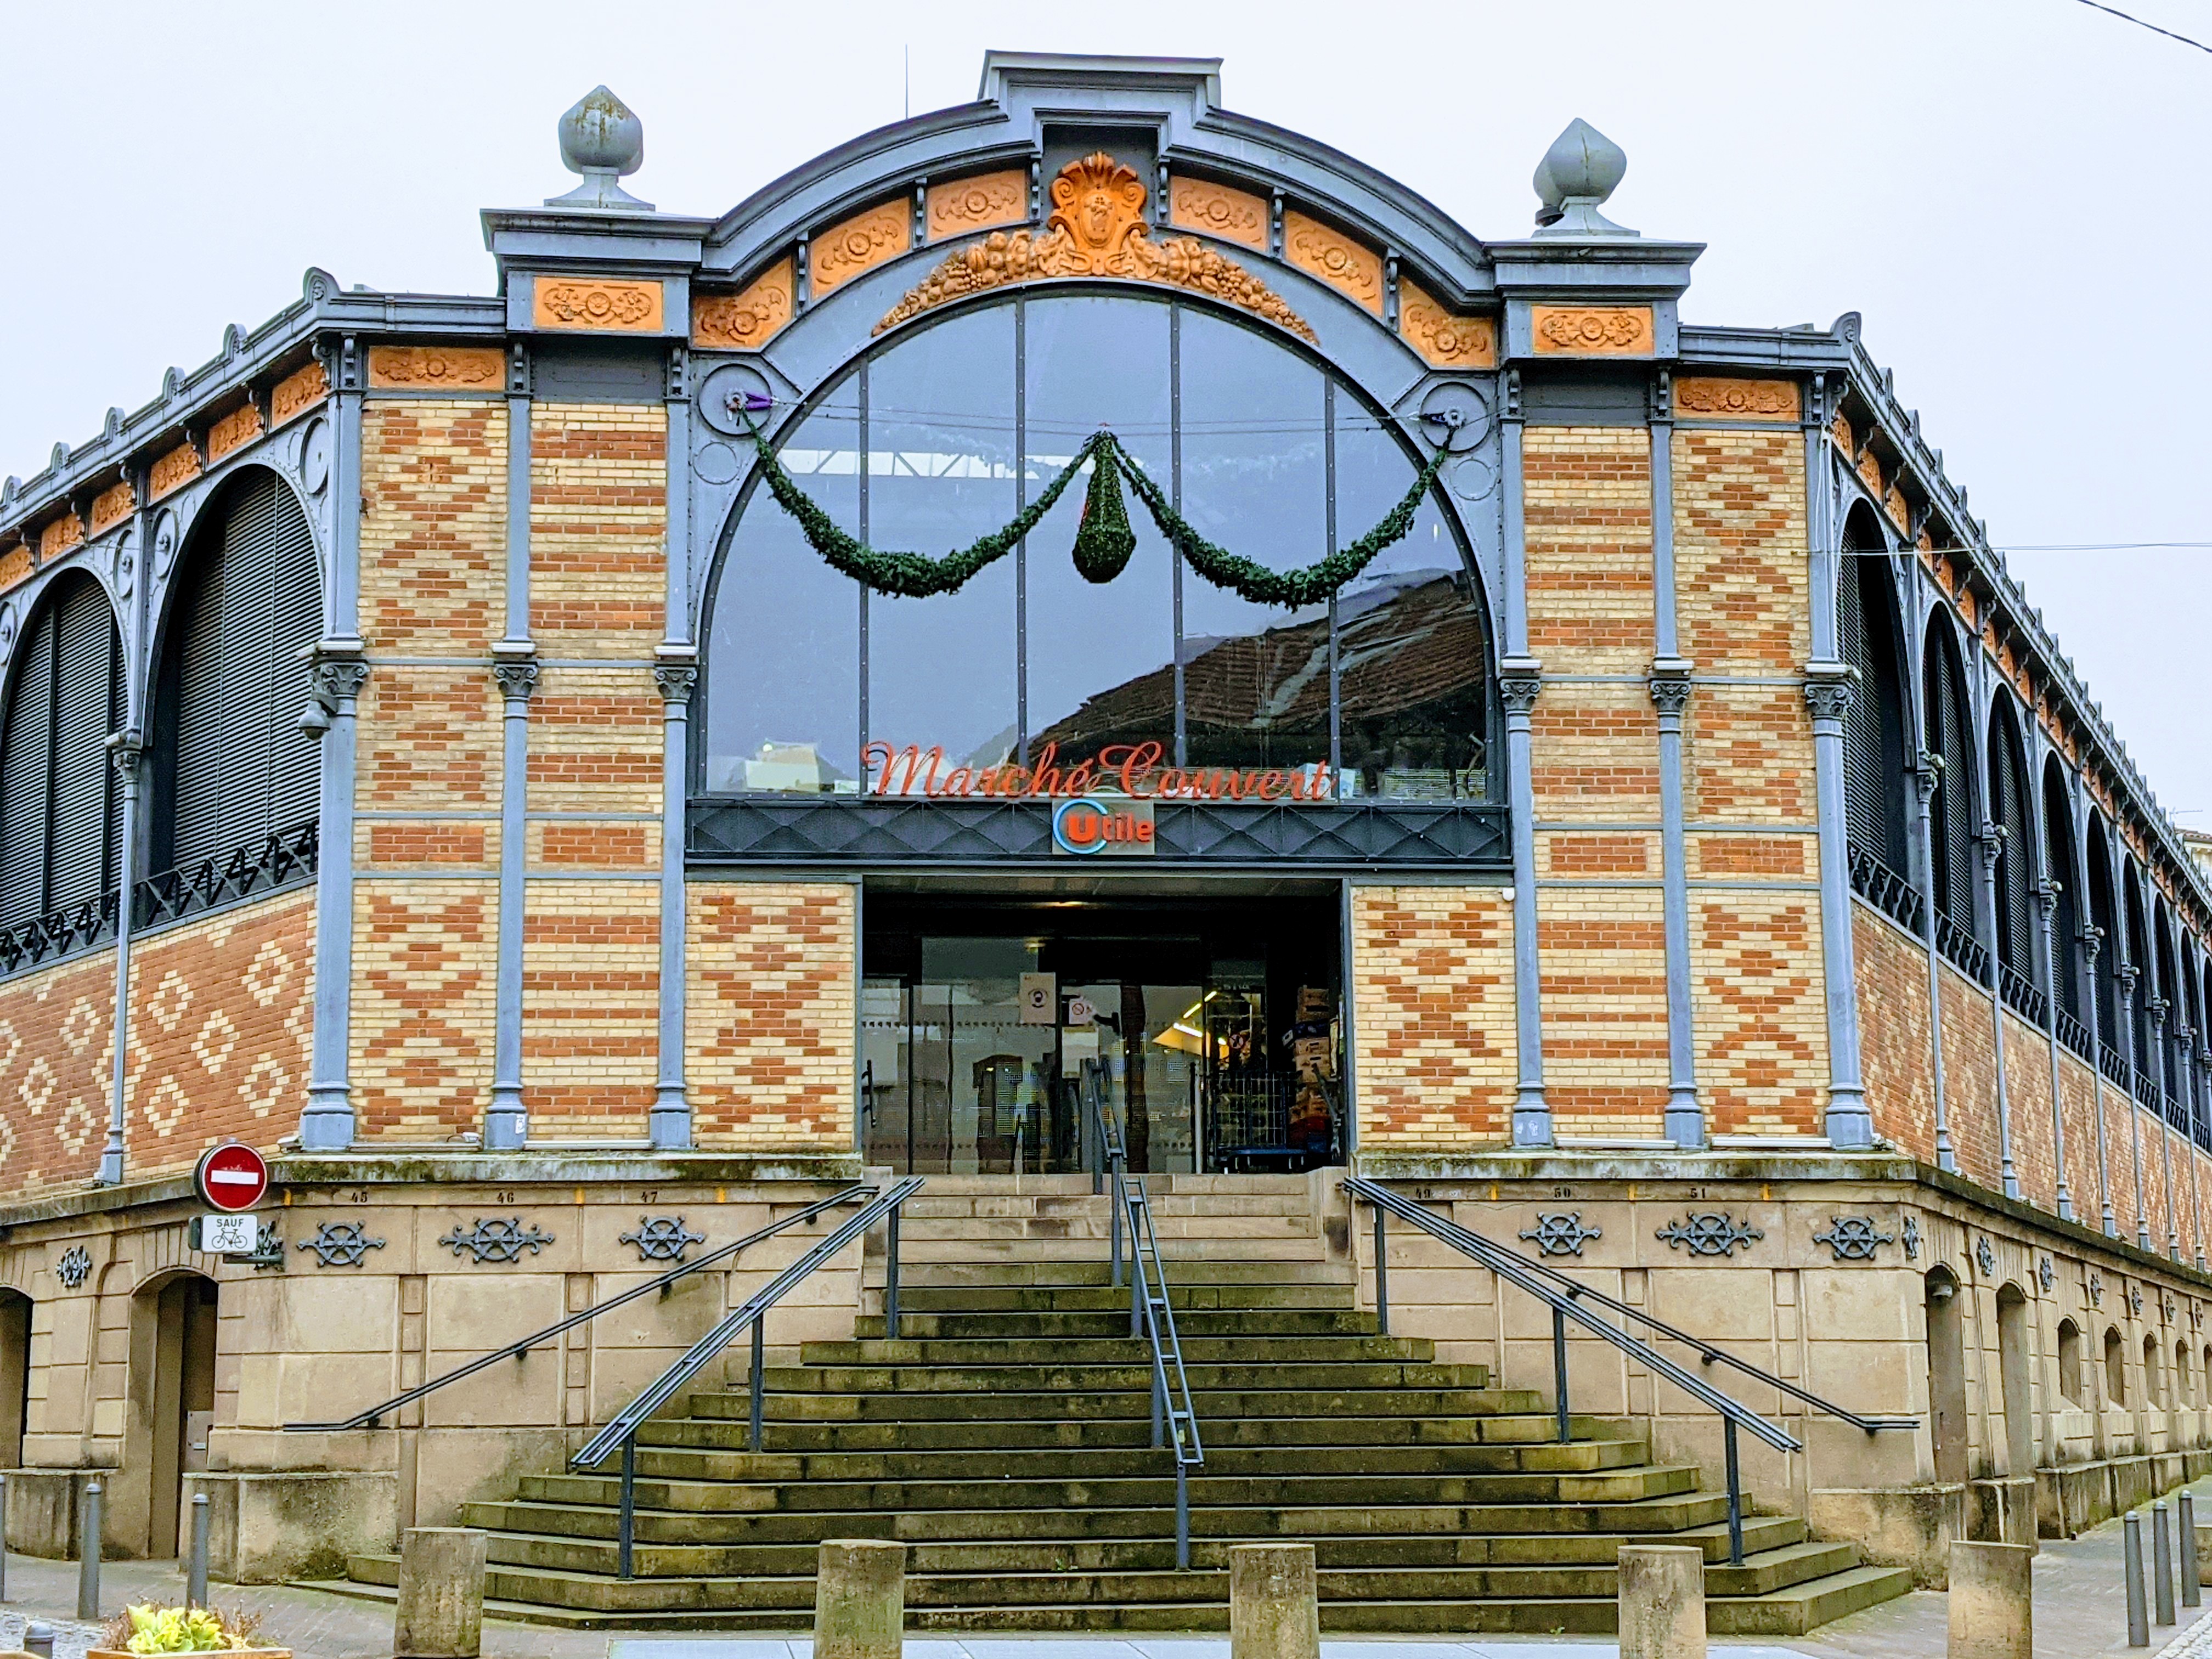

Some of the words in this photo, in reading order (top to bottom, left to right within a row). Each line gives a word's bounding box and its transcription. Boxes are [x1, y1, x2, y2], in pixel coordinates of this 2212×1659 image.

[861, 741, 1102, 798] Marché
[1099, 740, 1338, 800] Couvert
[1065, 812, 1155, 844] Utile
[497, 1192, 514, 1204] 46
[641, 1191, 658, 1203] 47
[1554, 1187, 1571, 1198] 50
[1690, 1188, 1705, 1199] 51
[216, 1218, 244, 1228] SAUF
